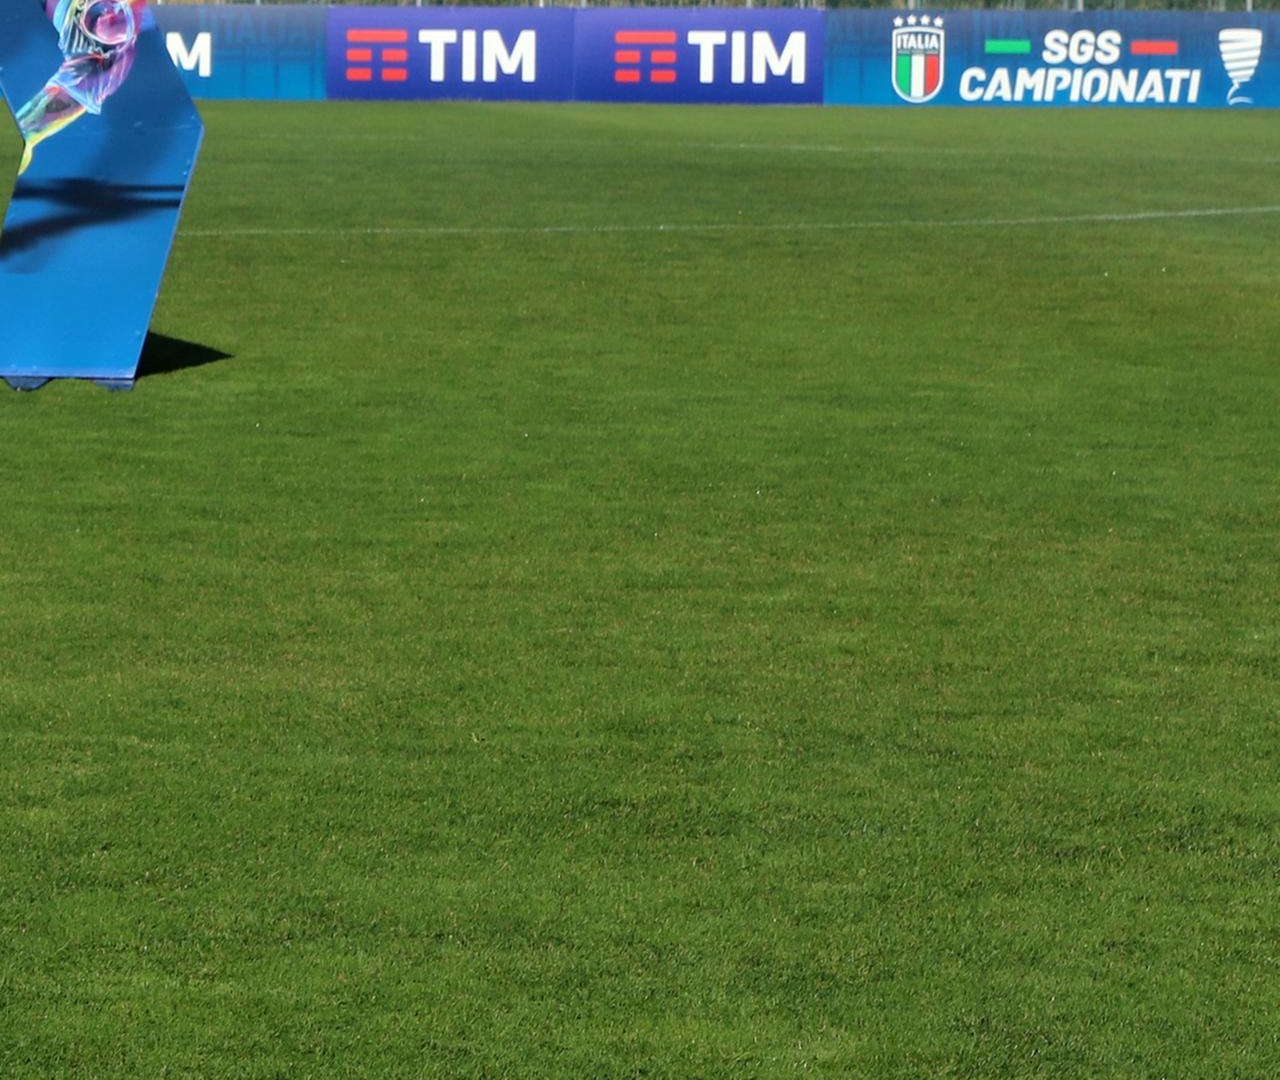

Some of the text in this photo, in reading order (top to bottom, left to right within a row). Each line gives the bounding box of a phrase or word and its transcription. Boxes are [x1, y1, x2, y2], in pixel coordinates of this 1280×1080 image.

[419, 29, 536, 83] TIM
[688, 30, 806, 84] TIM
[896, 33, 940, 50] ITALIA
[1041, 29, 1122, 65] SGS
[958, 66, 1201, 104] CAMPIONATI
